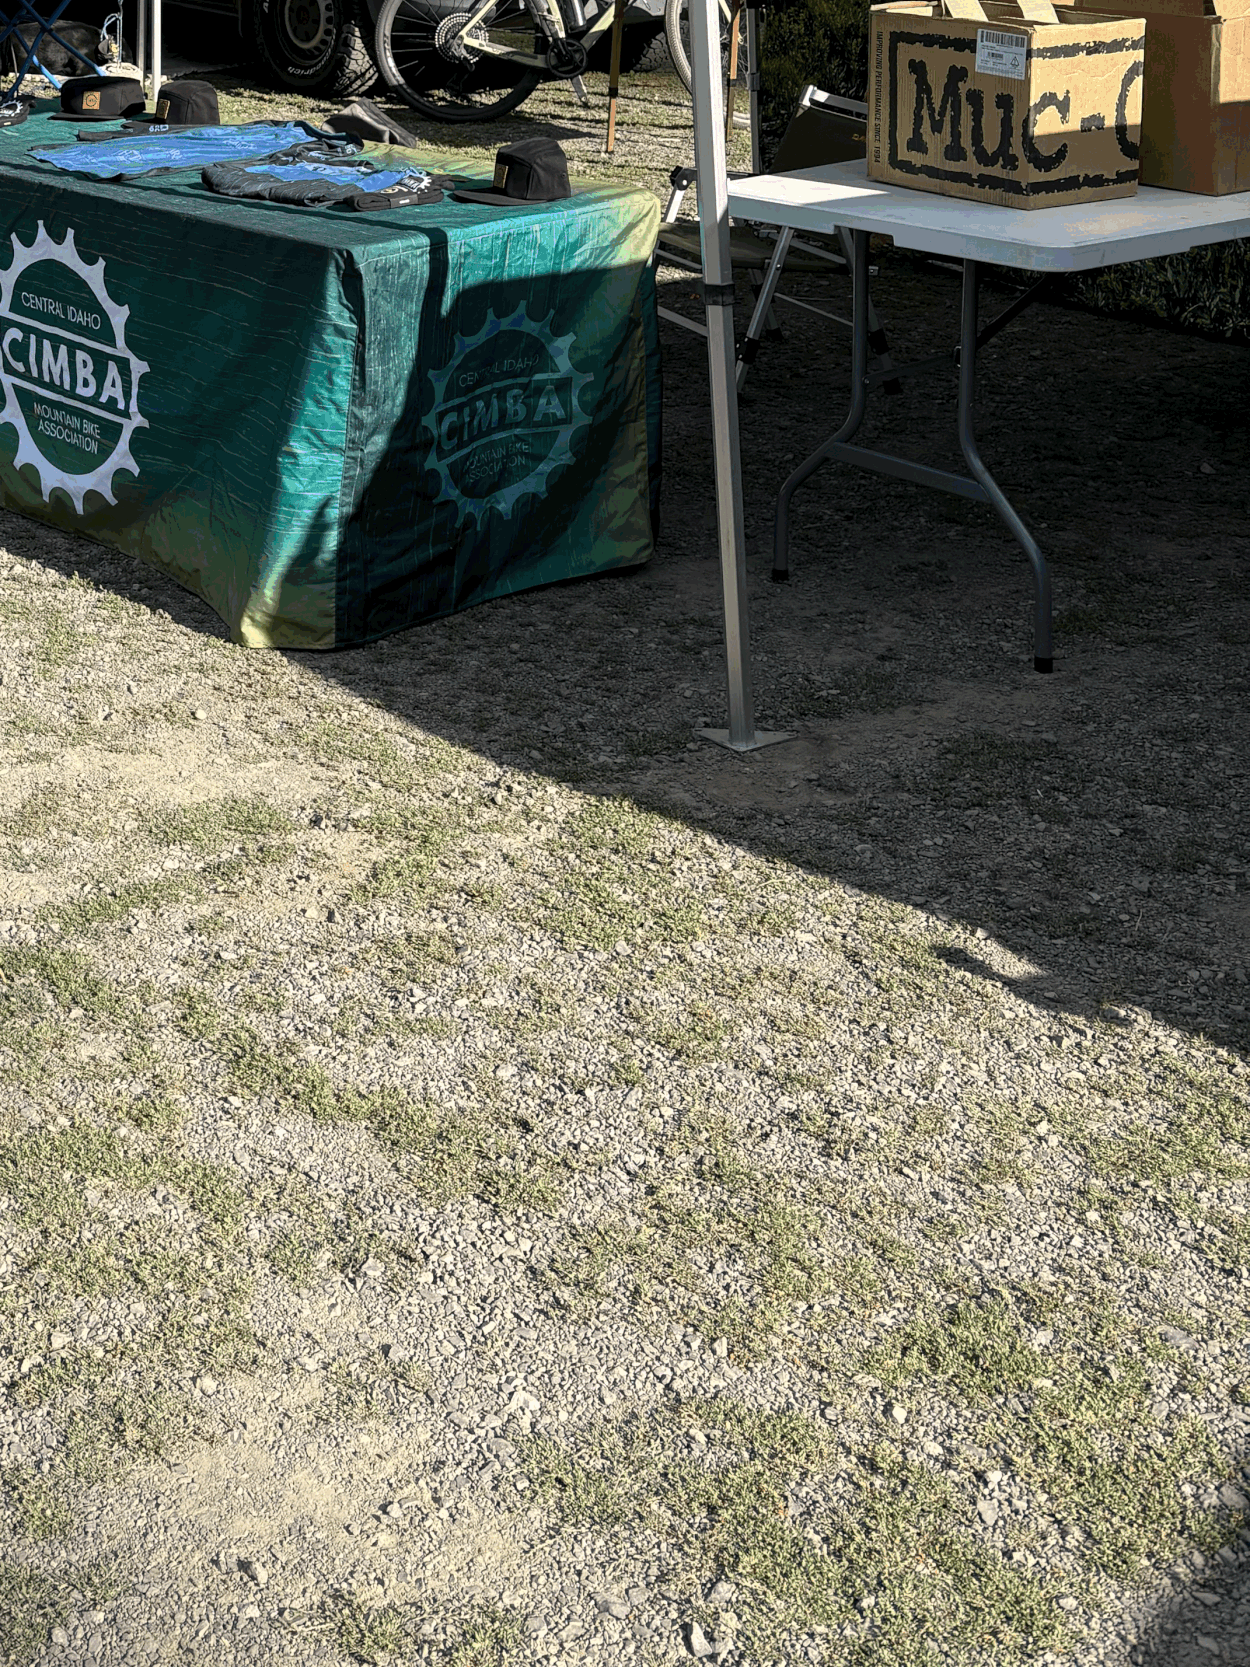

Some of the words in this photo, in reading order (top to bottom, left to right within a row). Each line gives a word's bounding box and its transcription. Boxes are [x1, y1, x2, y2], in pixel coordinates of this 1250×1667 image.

[875, 31, 883, 69] IMPROVING
[874, 70, 883, 123] PERFORMANCE
[21, 291, 66, 319] CENTRAL
[66, 305, 101, 330] IDAHO
[2, 327, 125, 411] CIMBA
[458, 362, 500, 387] CENTRAL
[503, 354, 540, 372] IDAHO
[34, 401, 81, 431] MOUNTAIN
[82, 419, 101, 439] BIKE
[38, 418, 99, 454] ASSOCIATION
[440, 385, 567, 450] CIMBA
[507, 441, 530, 455] BIKE
